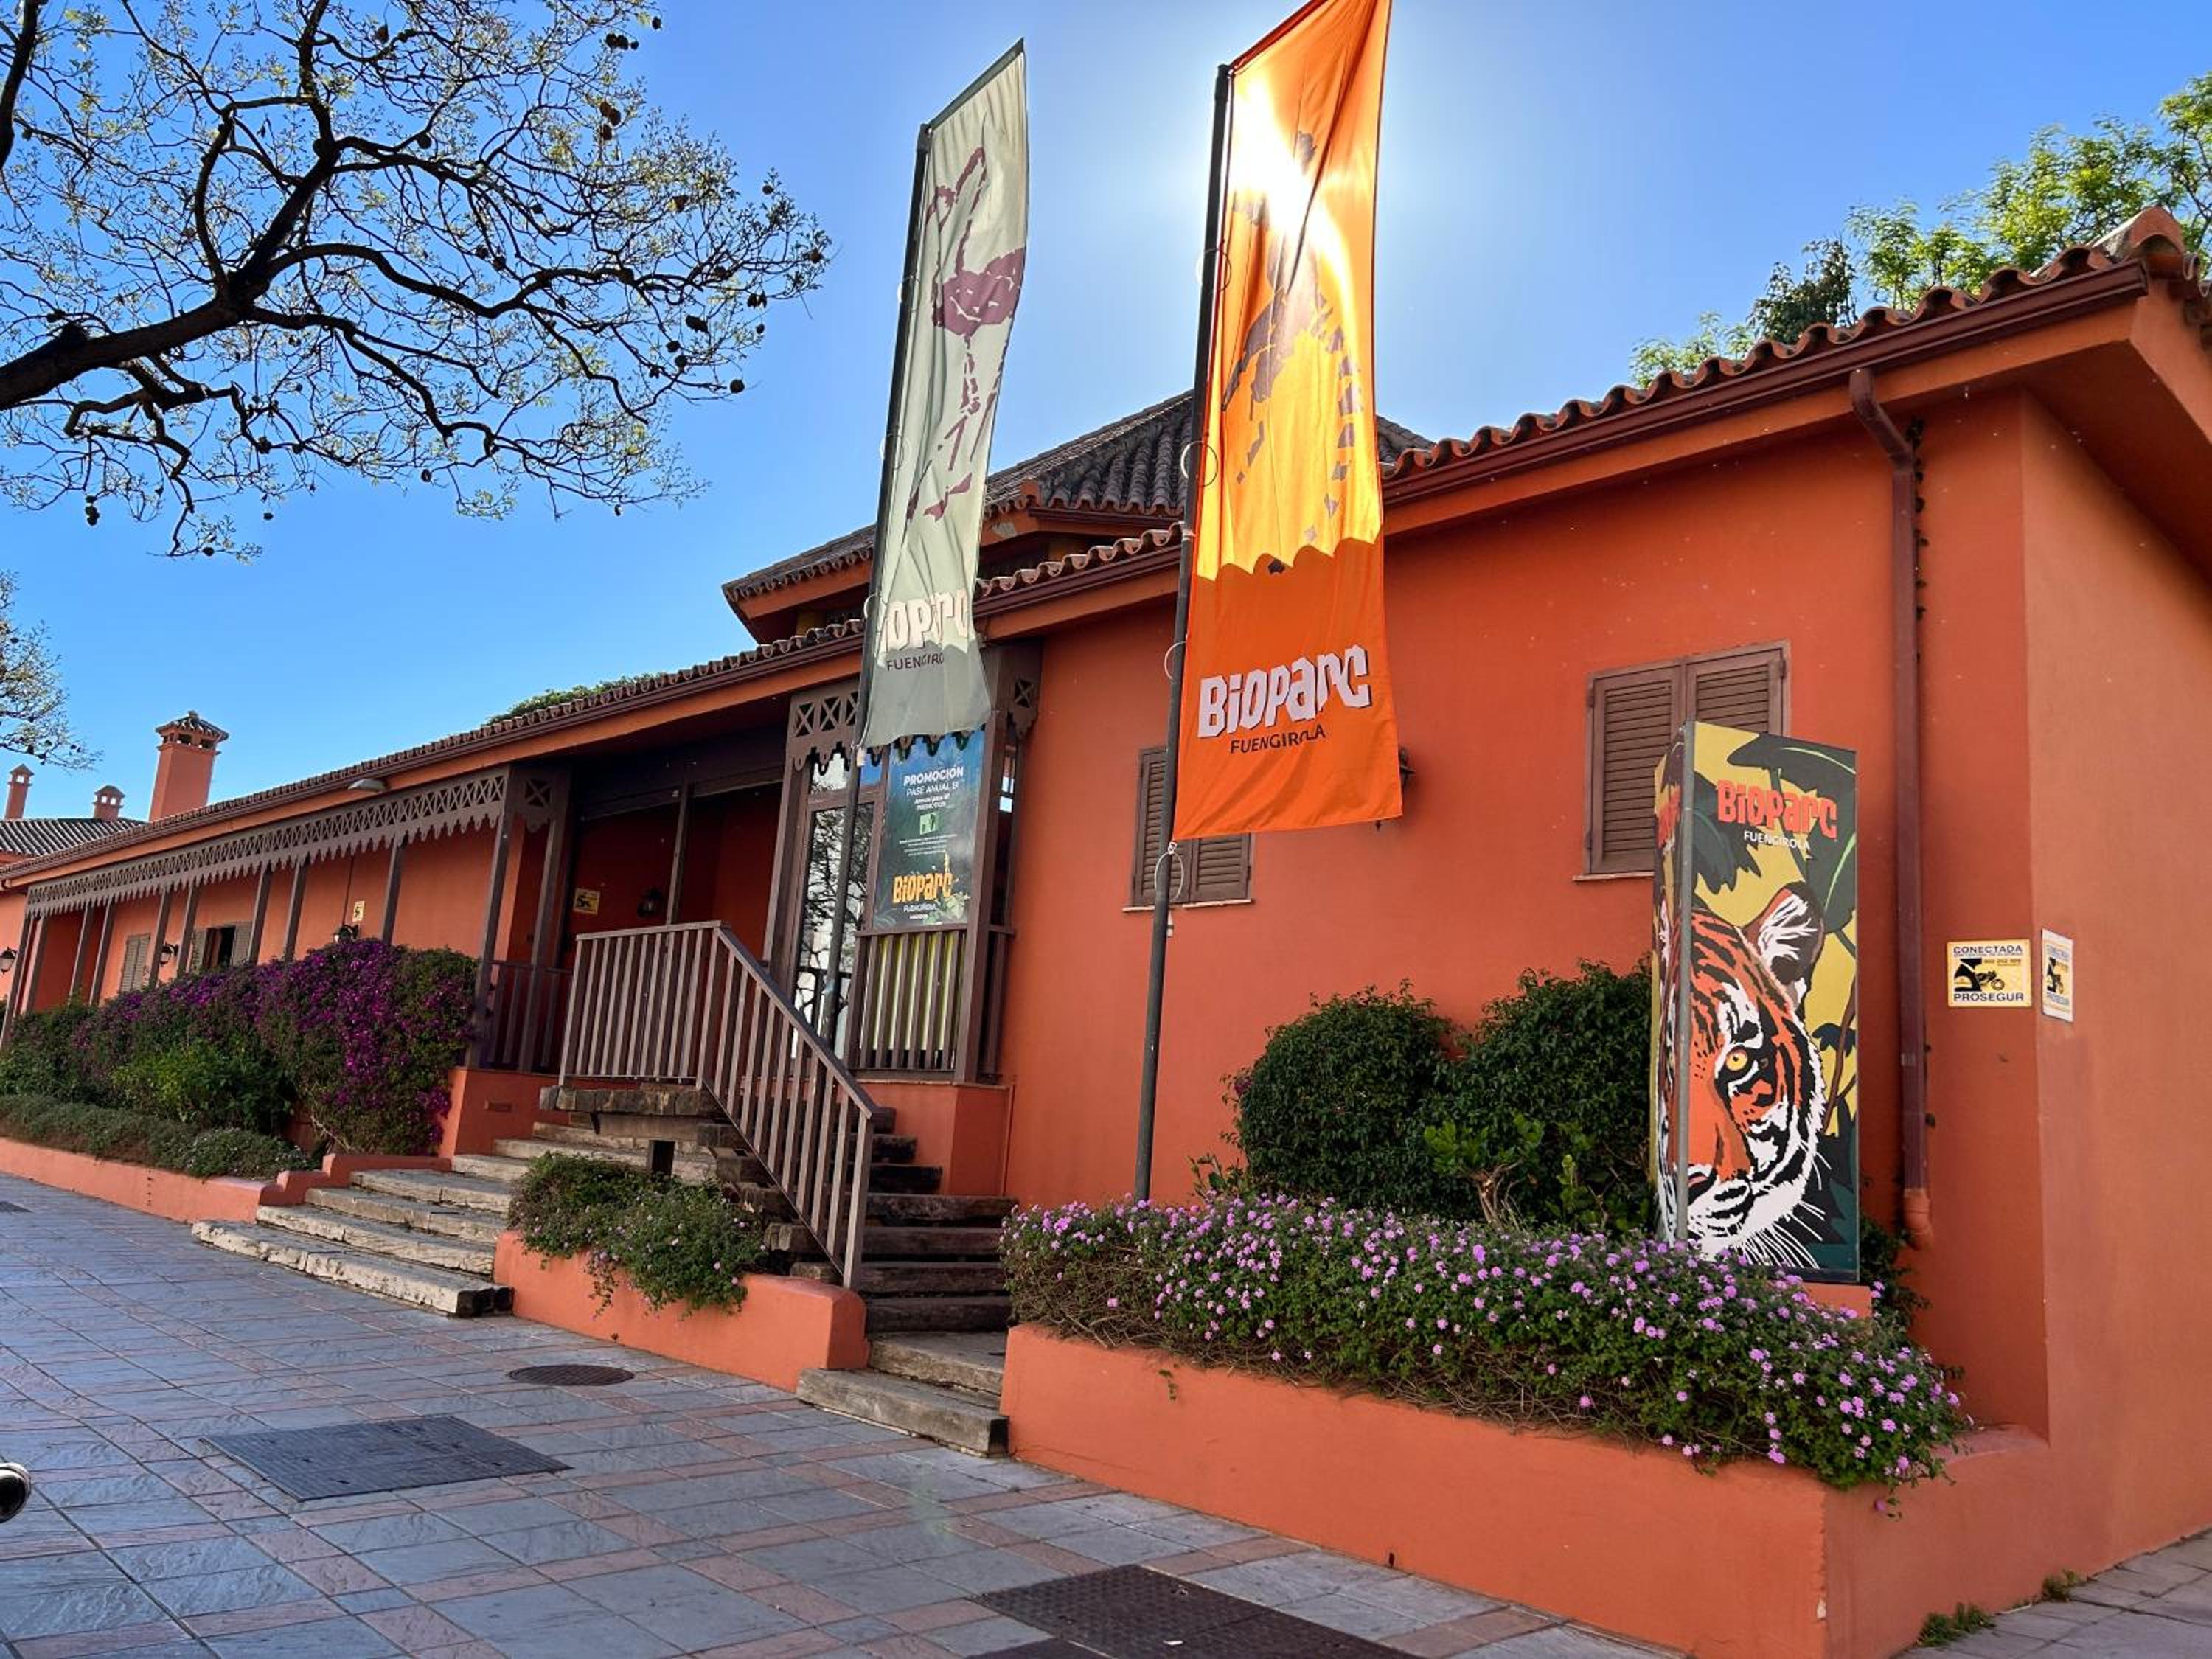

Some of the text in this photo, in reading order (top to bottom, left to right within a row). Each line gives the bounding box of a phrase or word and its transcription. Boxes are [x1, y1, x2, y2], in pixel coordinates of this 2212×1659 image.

[903, 764, 964, 787] PROMOCIÓN
[906, 785, 925, 797] PASE
[926, 782, 949, 793] ANUAL
[1743, 830, 1811, 851] FUENGIROLA
[1953, 945, 2023, 954] CONECTADA
[1953, 992, 2024, 1001] PROSEGUR
